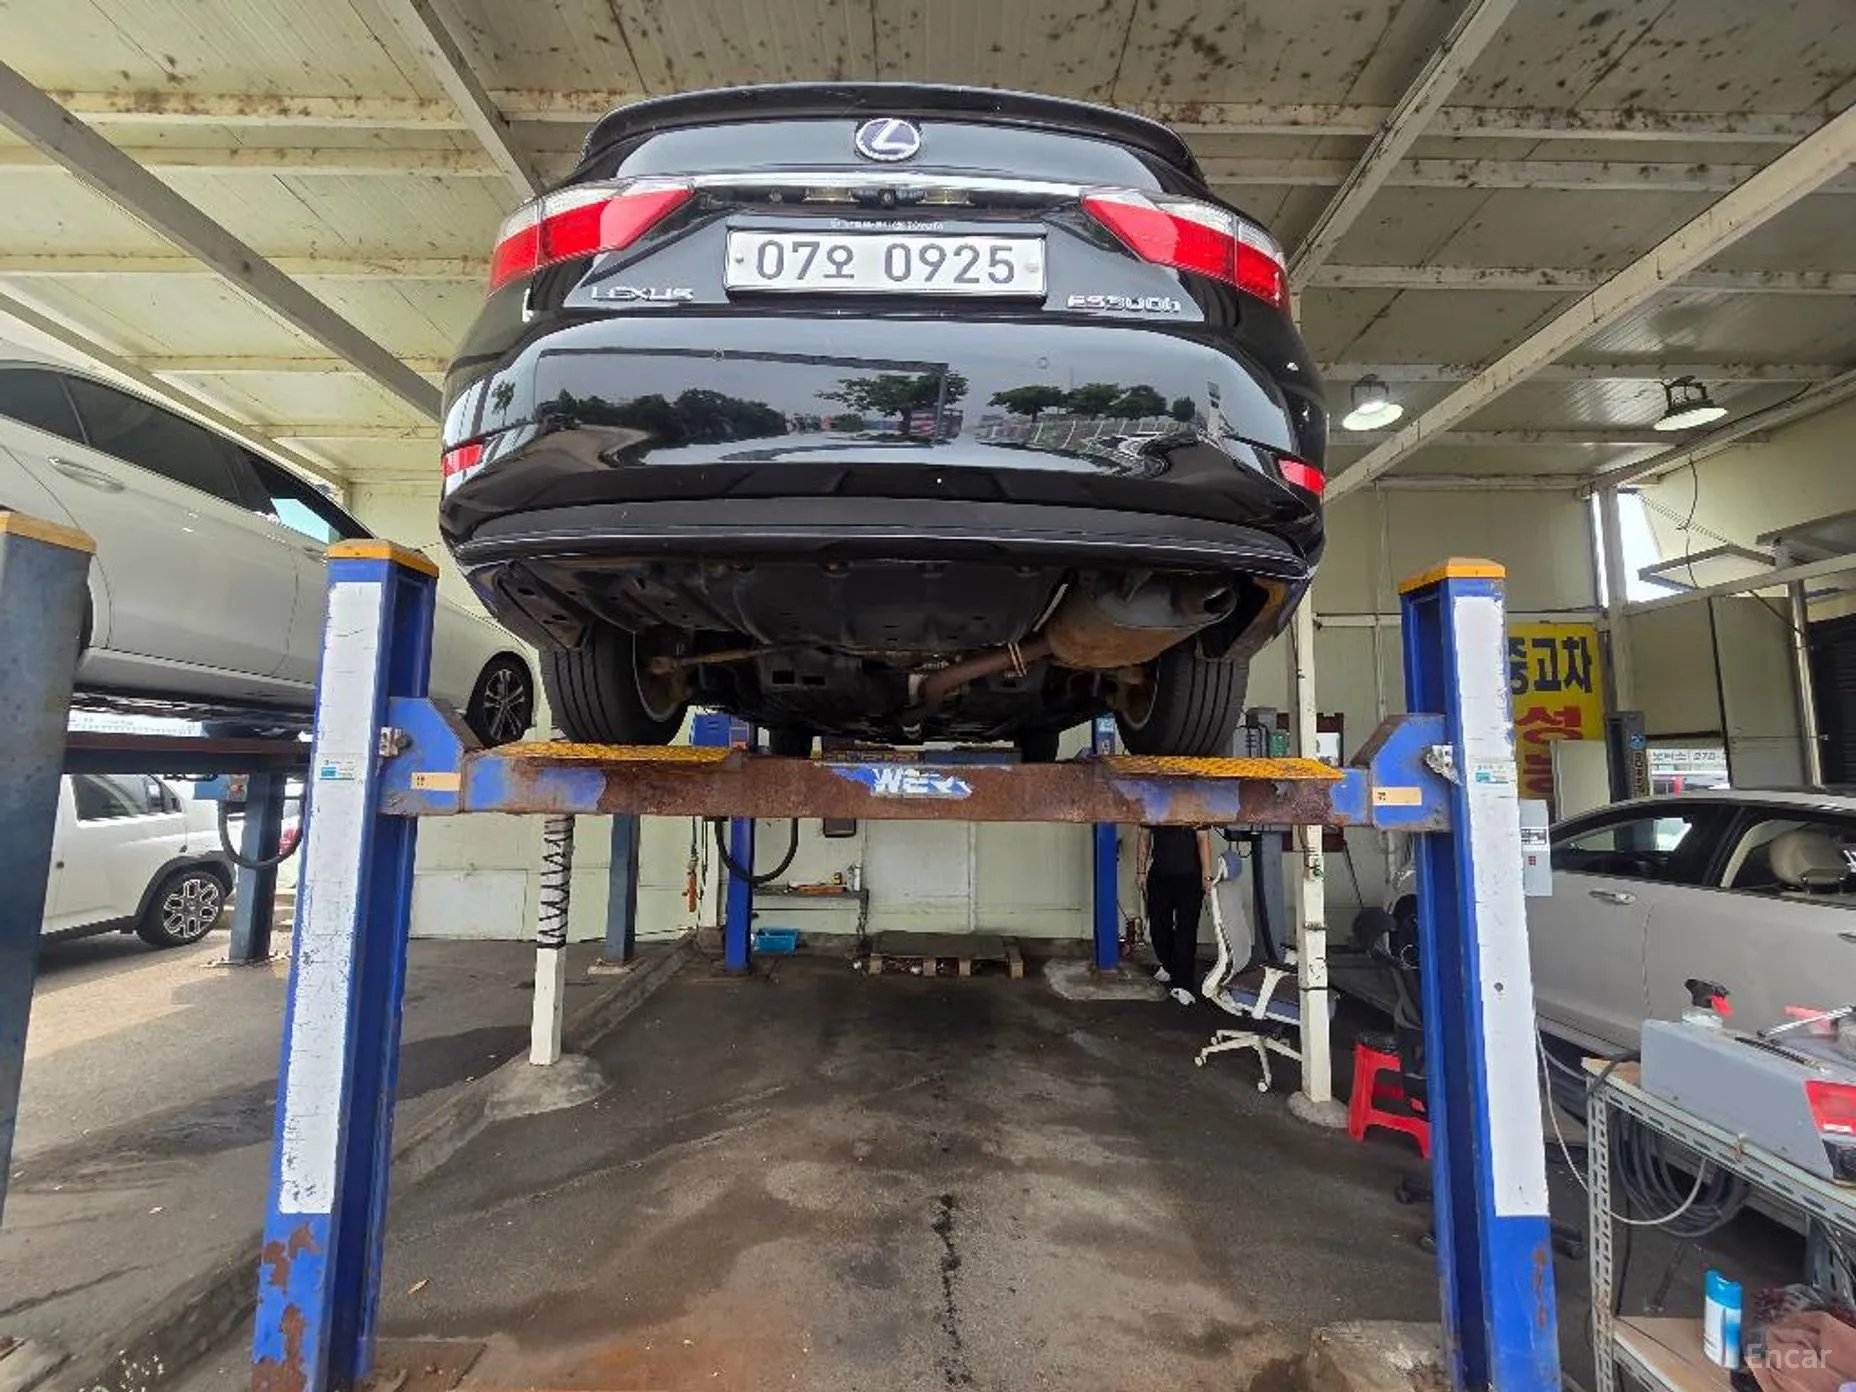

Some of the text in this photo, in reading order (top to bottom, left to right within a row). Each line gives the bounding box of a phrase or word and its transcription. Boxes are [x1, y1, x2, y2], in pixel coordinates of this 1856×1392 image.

[755, 239, 1015, 284] 07오 0925
[592, 286, 694, 301] LEXUS
